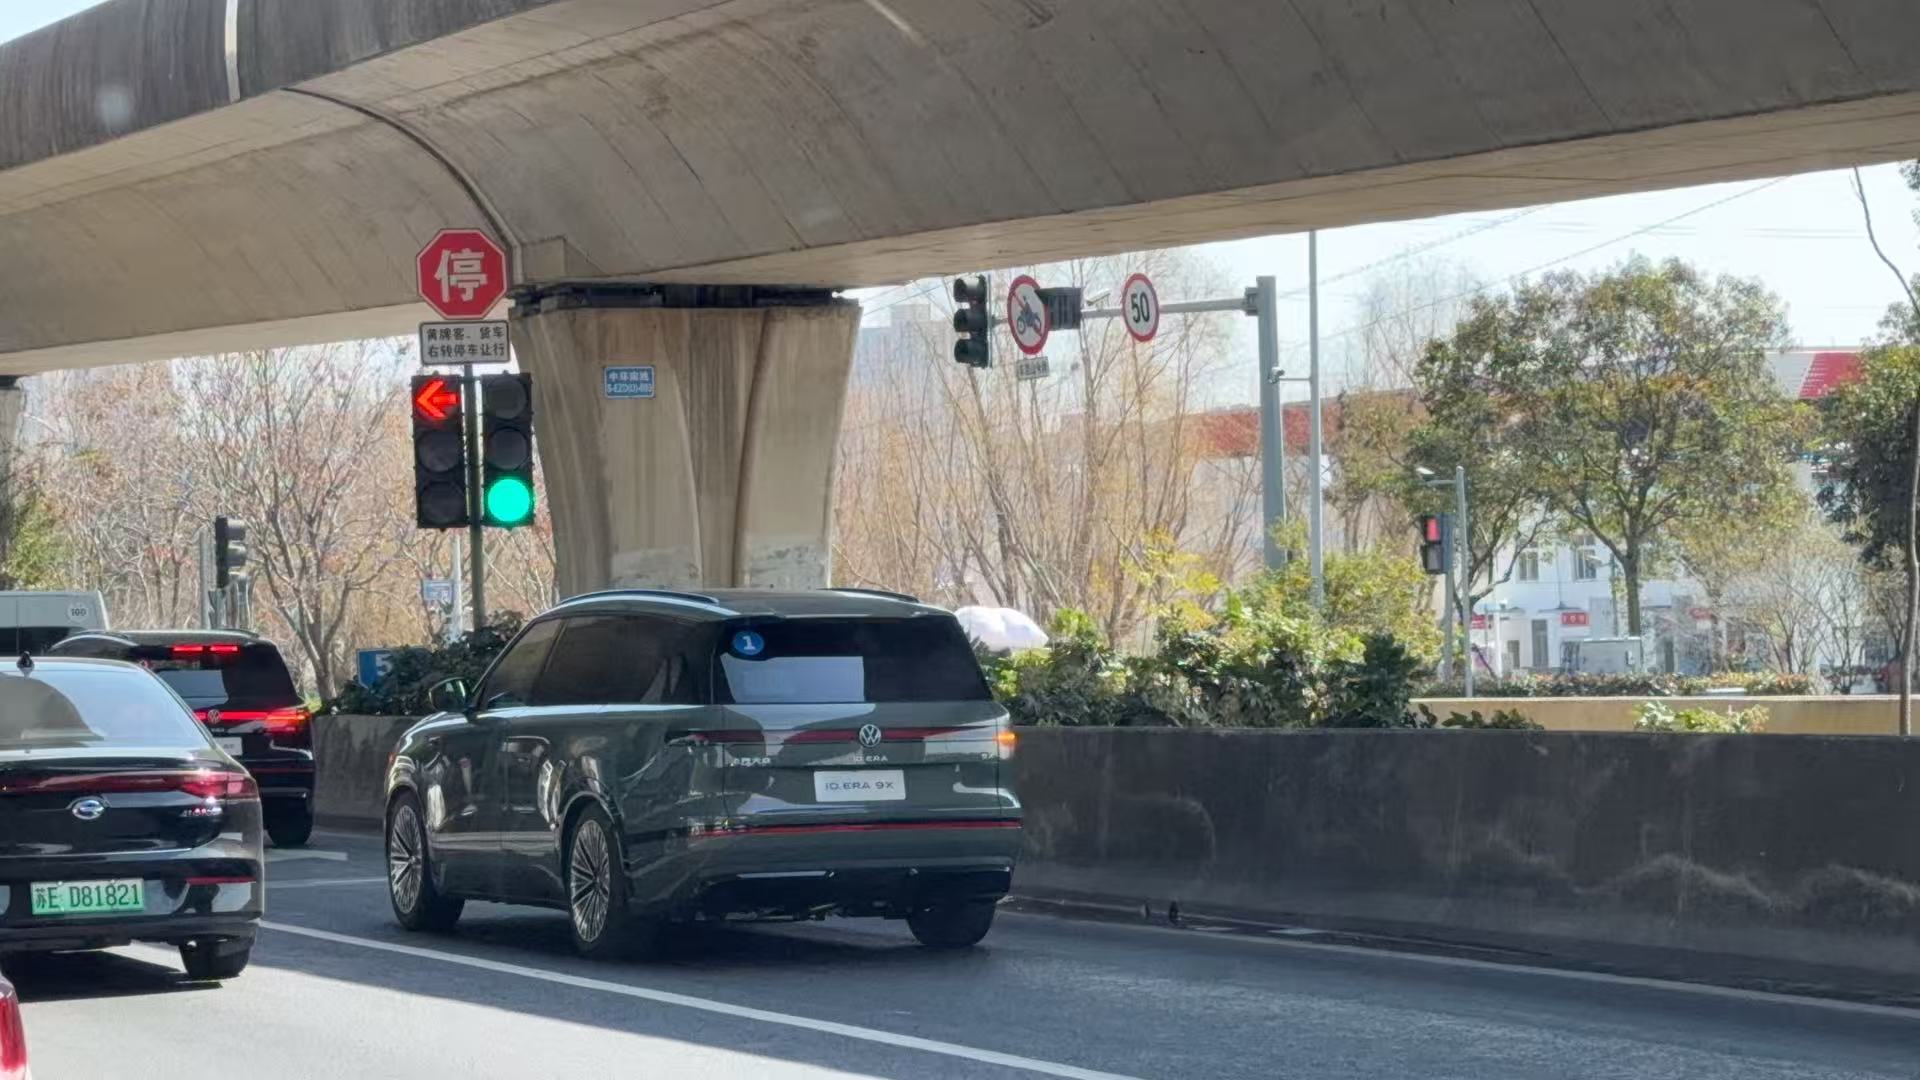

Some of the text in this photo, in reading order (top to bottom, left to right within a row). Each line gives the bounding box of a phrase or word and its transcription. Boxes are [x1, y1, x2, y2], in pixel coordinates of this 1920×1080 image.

[434, 248, 488, 303] 停
[1131, 291, 1150, 323] 50
[428, 343, 504, 358] 右转停车让行
[742, 636, 756, 650] 1
[875, 781, 894, 790] 9X
